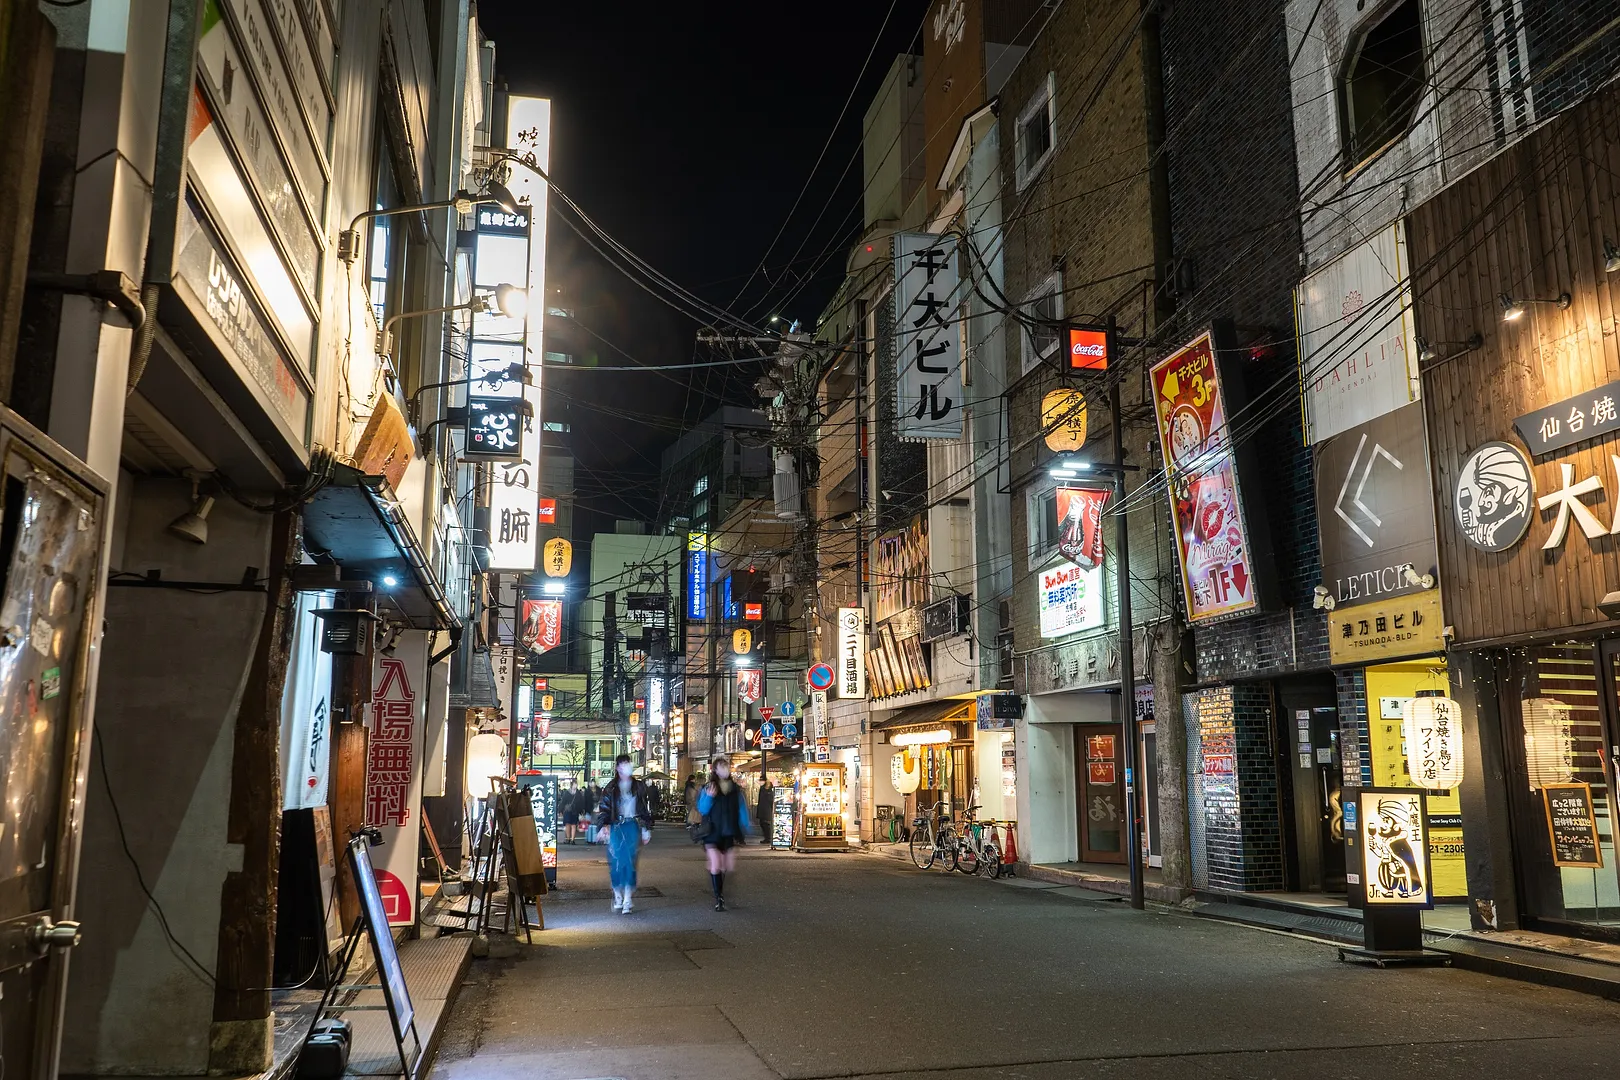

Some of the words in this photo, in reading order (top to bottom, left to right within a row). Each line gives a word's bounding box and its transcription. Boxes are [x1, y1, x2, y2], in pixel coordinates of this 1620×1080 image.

[912, 248, 953, 422] 千大ビル
[1072, 343, 1105, 357] Coca-Cola
[1178, 353, 1208, 381] 千大ビル
[1314, 335, 1405, 394] DAHLIA
[1341, 372, 1378, 394] SENDAI
[1191, 374, 1213, 407] 3F
[1538, 395, 1618, 443] 仙台焼
[1536, 453, 1620, 550] 大
[552, 541, 565, 572] 虎屋横丁
[1048, 582, 1077, 608] 無料案内所
[1194, 590, 1212, 607] 地下
[1209, 567, 1231, 604] 1F
[543, 605, 558, 646] Coca-Cola
[1342, 609, 1424, 639] 津乃田ビル
[845, 633, 858, 694] 二丁目酒場
[366, 657, 416, 828] 入場無料
[1420, 727, 1437, 780] ワインの店
[1434, 702, 1452, 771] 仙台焼き鳥と
[1206, 758, 1231, 771] テナント募集
[1369, 884, 1382, 899] Jr.
